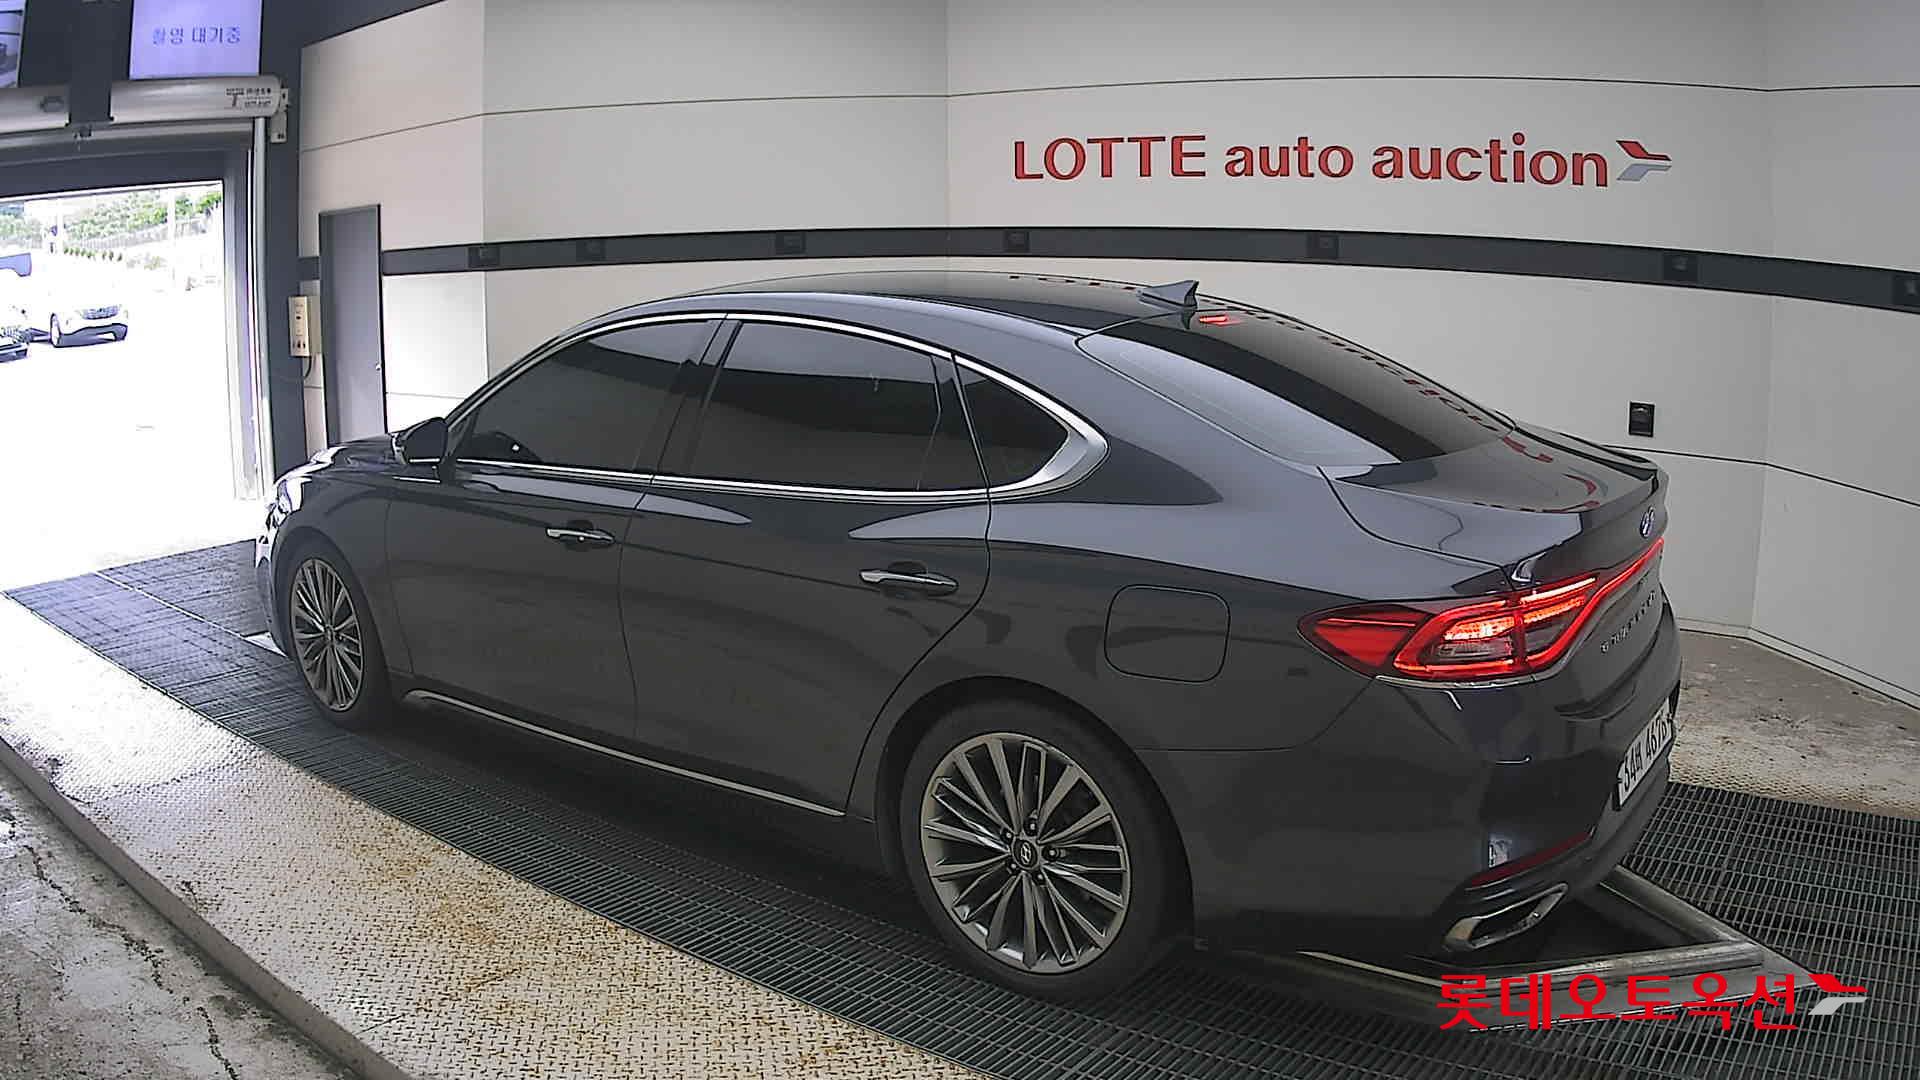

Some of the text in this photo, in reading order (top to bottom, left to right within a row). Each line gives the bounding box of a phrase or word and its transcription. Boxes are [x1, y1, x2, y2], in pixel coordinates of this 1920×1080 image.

[191, 26, 241, 45] 대기중
[1014, 132, 1608, 188] LOTTE auto auction
